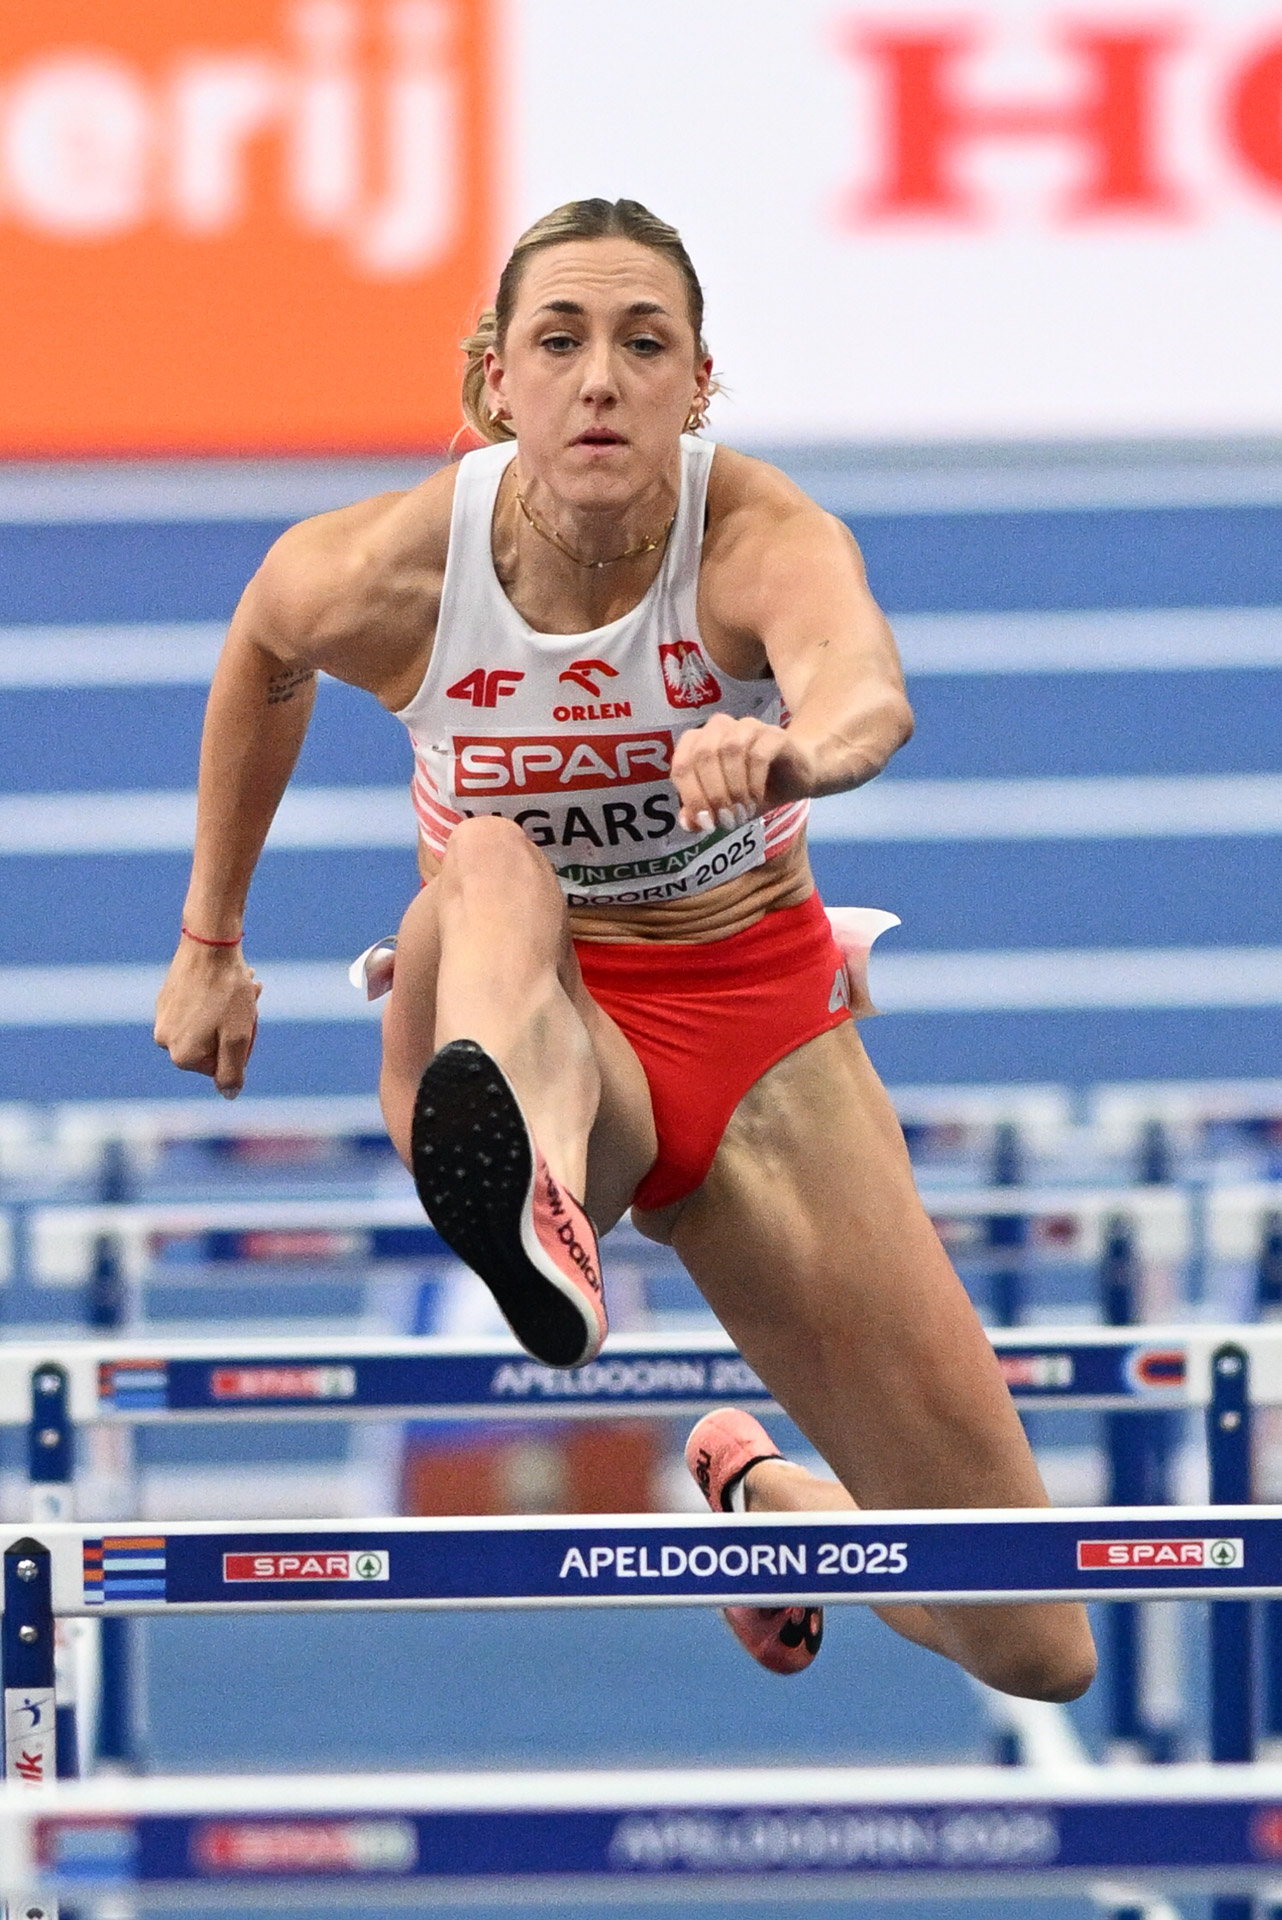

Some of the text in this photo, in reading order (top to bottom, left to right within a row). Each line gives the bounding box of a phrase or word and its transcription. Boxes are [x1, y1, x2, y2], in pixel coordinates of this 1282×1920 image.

[446, 668, 525, 708] 4F
[553, 702, 632, 722] ORLEN
[461, 739, 671, 790] SPAR
[463, 793, 683, 846] GARS
[555, 845, 700, 885] UN CLEAN
[567, 831, 757, 907] DOORN 2025
[253, 1557, 348, 1577] SPAR
[559, 1542, 908, 1578] APELDOORN 2025
[1108, 1544, 1203, 1564] SPAR
